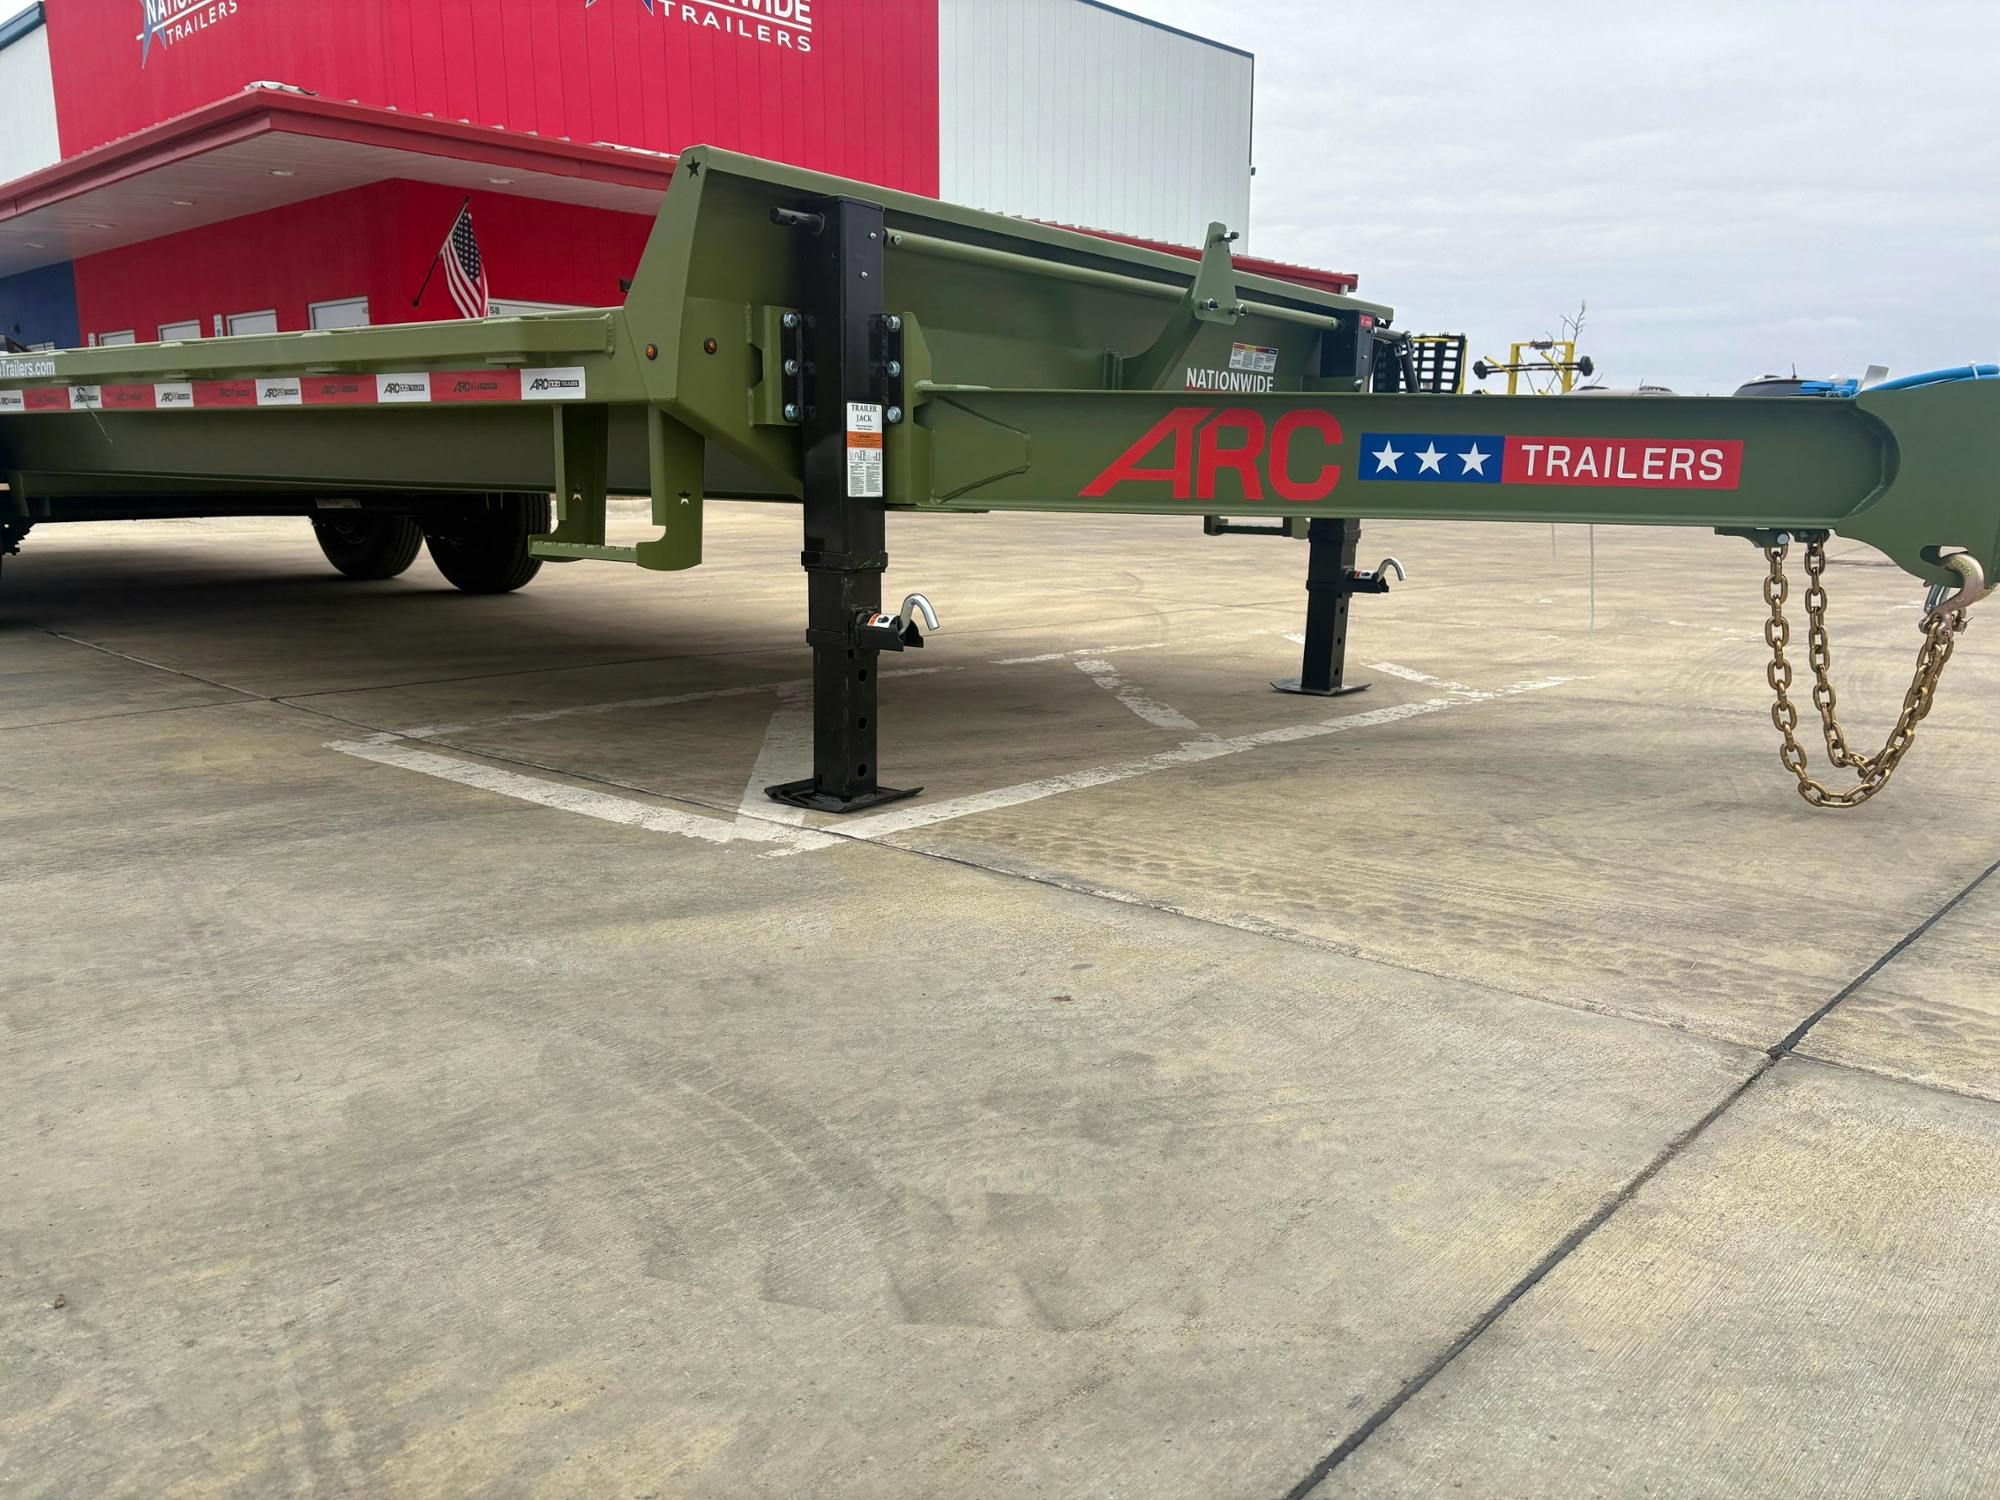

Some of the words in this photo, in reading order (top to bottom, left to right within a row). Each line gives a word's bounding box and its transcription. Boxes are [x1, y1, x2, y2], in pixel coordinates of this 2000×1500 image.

[167, 0, 238, 45] TRAILERS
[657, 0, 812, 52] TRAILERS
[1186, 367, 1274, 392] NATIONWIDE
[851, 404, 877, 412] TRAILER
[856, 414, 872, 423] JACK
[1078, 407, 1344, 502] ARC
[1521, 444, 1724, 481] TRAILERS
